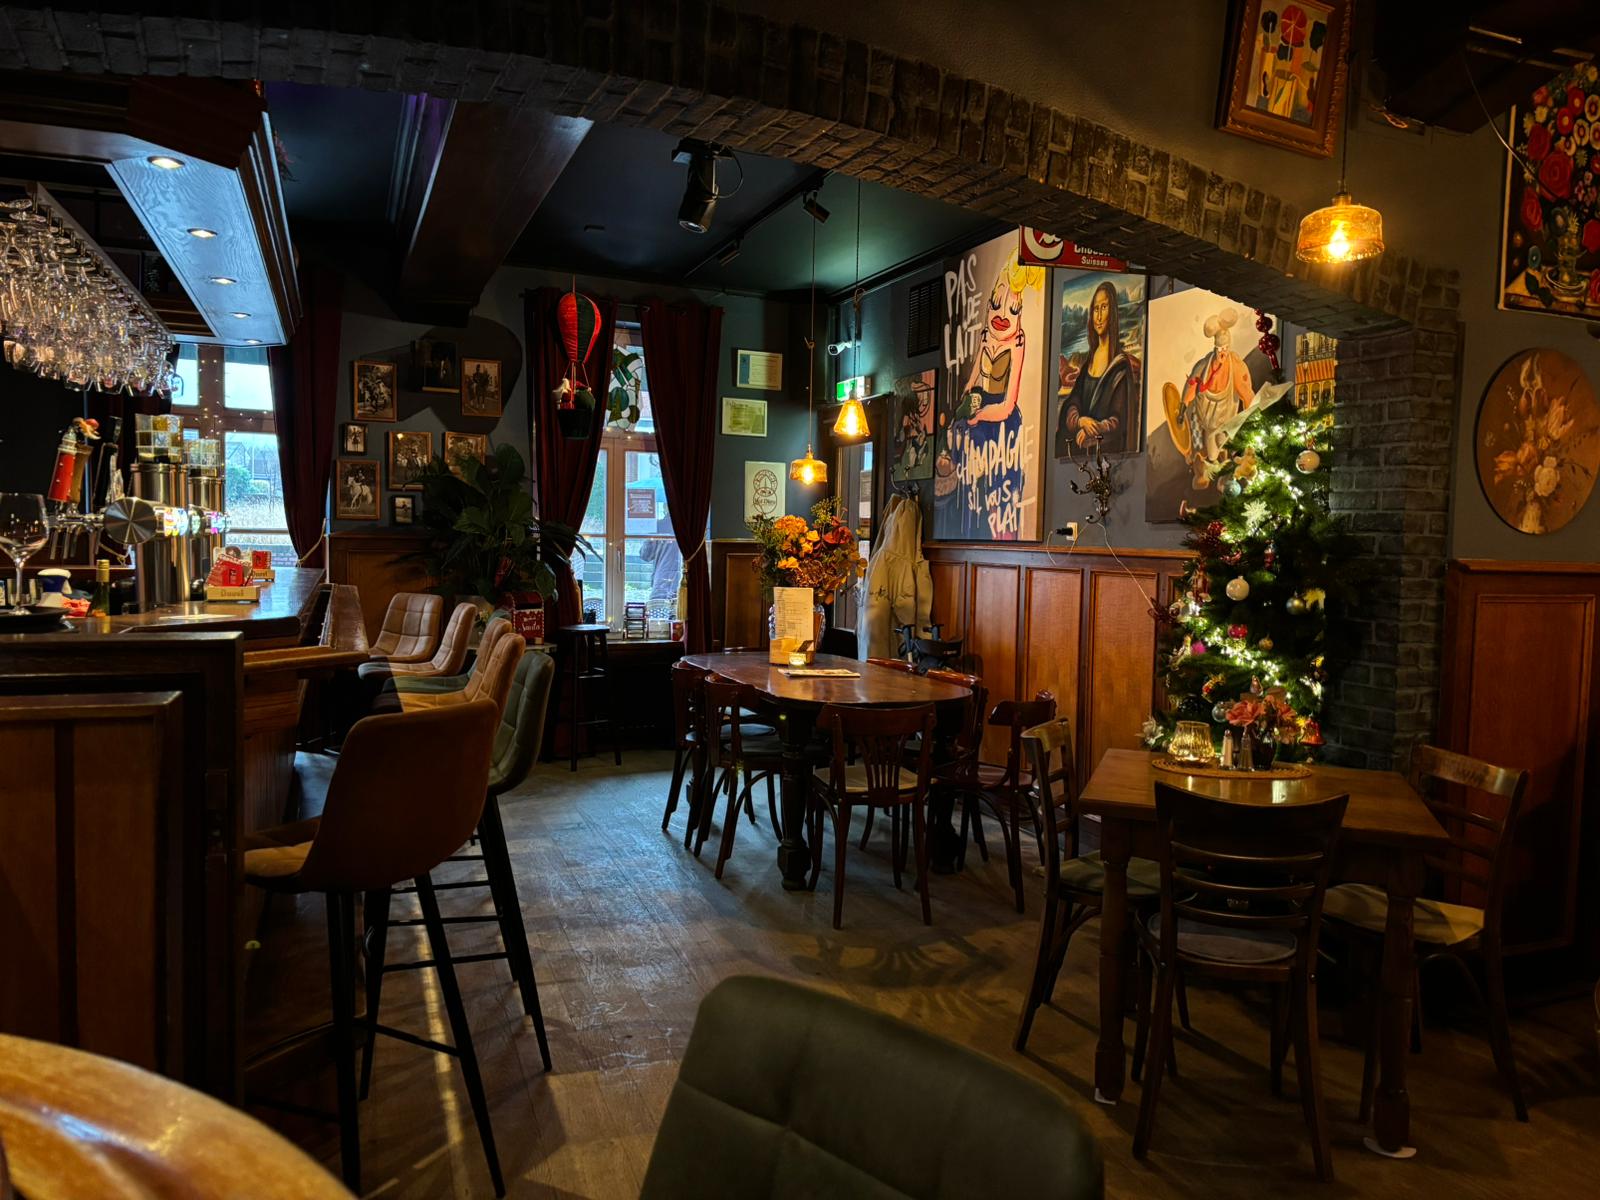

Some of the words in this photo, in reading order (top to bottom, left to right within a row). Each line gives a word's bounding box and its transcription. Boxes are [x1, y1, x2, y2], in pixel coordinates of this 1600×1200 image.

[945, 253, 977, 319] PAS
[1081, 256, 1109, 267] Suisses
[944, 323, 982, 375] LAIT
